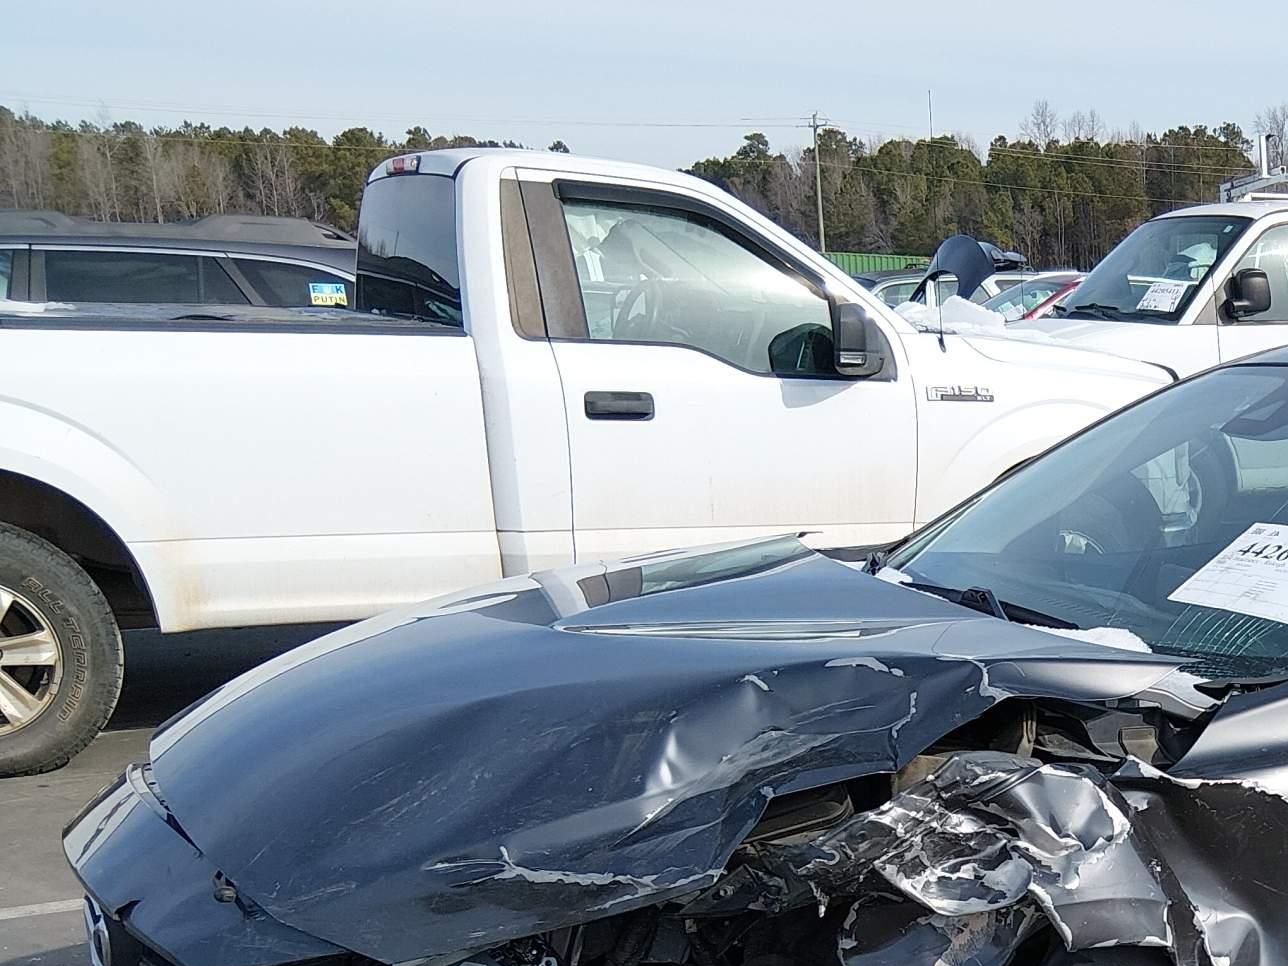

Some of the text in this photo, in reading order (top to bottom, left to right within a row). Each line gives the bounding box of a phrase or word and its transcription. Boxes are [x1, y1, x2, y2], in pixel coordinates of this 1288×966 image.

[313, 295, 346, 304] PUTIN
[24, 576, 88, 722] ALL TERRAIN
